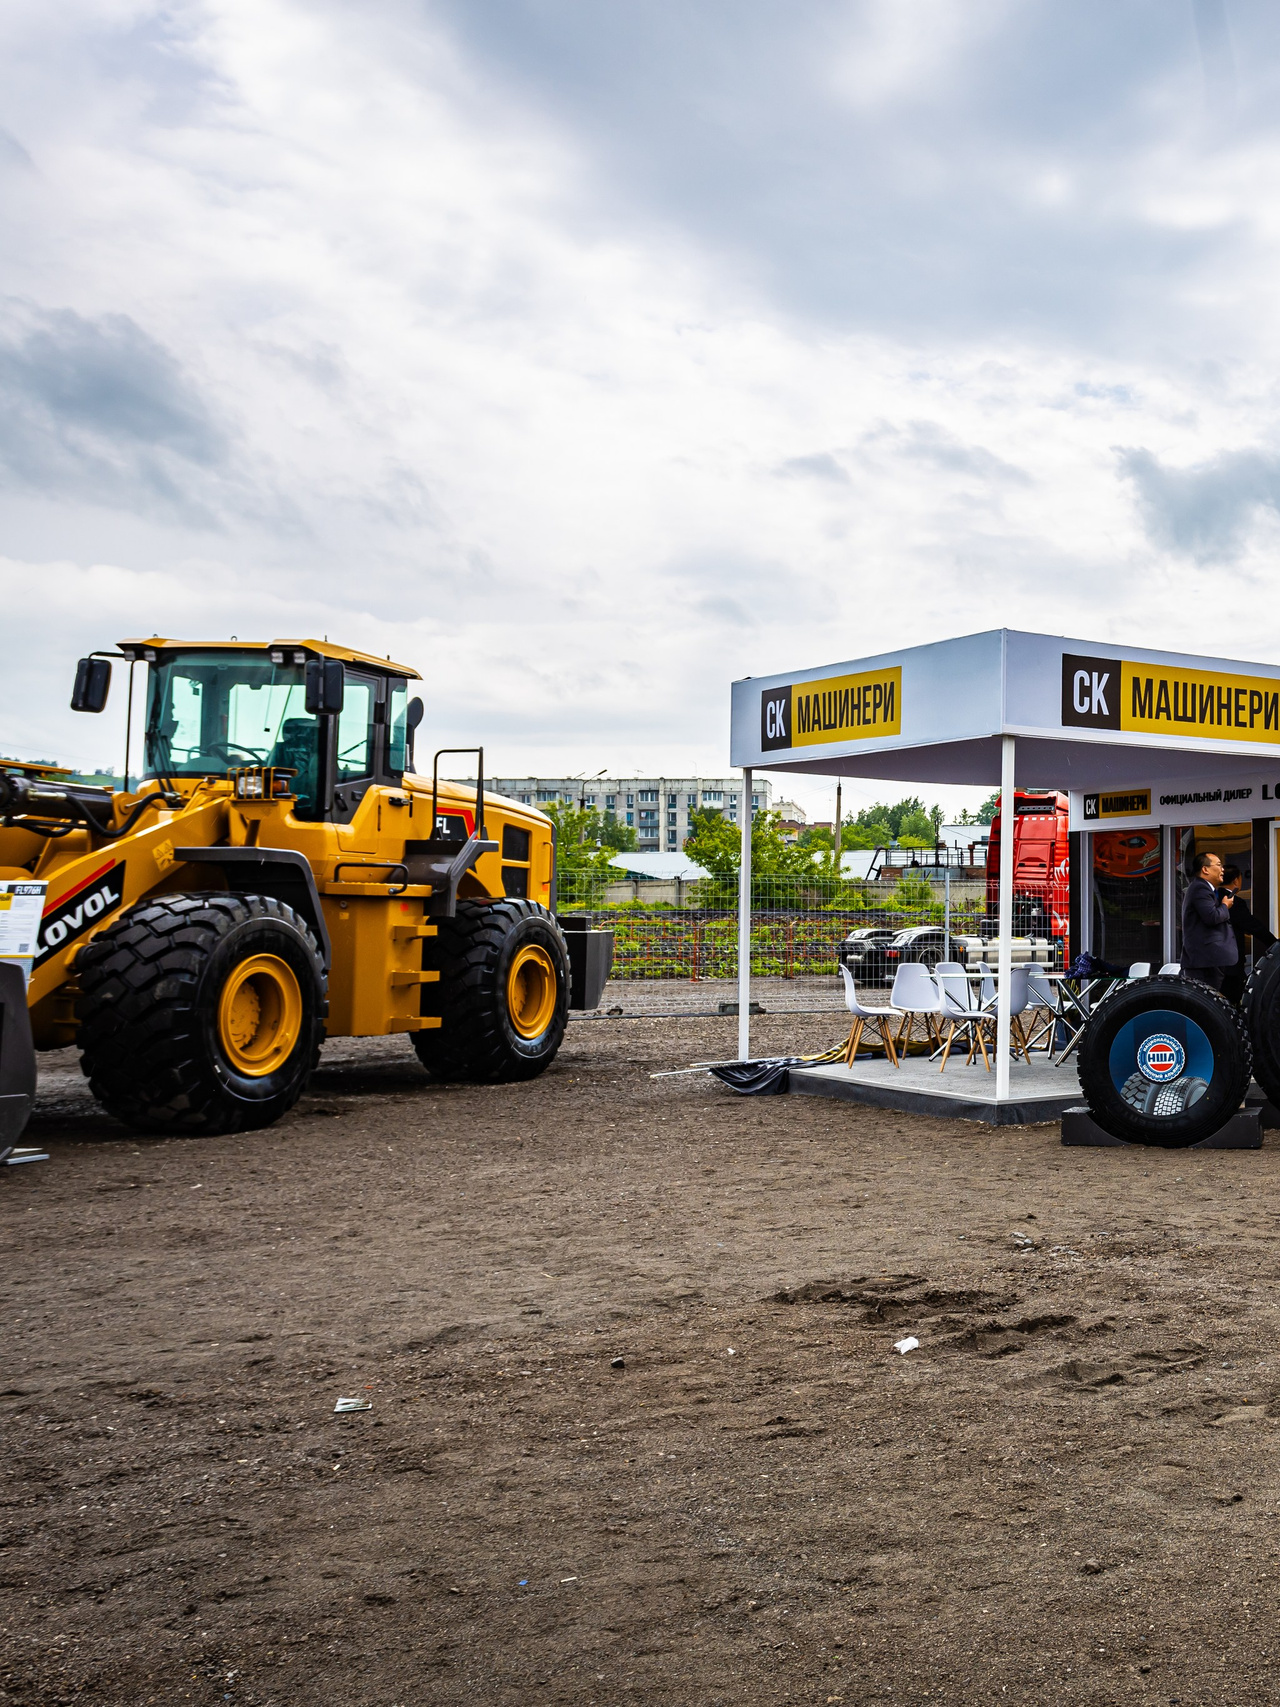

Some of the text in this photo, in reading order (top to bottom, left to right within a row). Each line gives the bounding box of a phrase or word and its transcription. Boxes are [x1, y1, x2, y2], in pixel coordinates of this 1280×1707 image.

[766, 681, 895, 739] СК МАШИНЕРИ
[1073, 669, 1280, 731] СК МАШИНЕРИ
[1085, 793, 1148, 815] СК МАШИНЕРИ
[1159, 788, 1253, 806] ОФИЦИАЛЬНЫЙ ДИЛЕР
[435, 816, 451, 834] FL
[34, 885, 120, 959] LOVOL
[1147, 1053, 1175, 1063] НША
